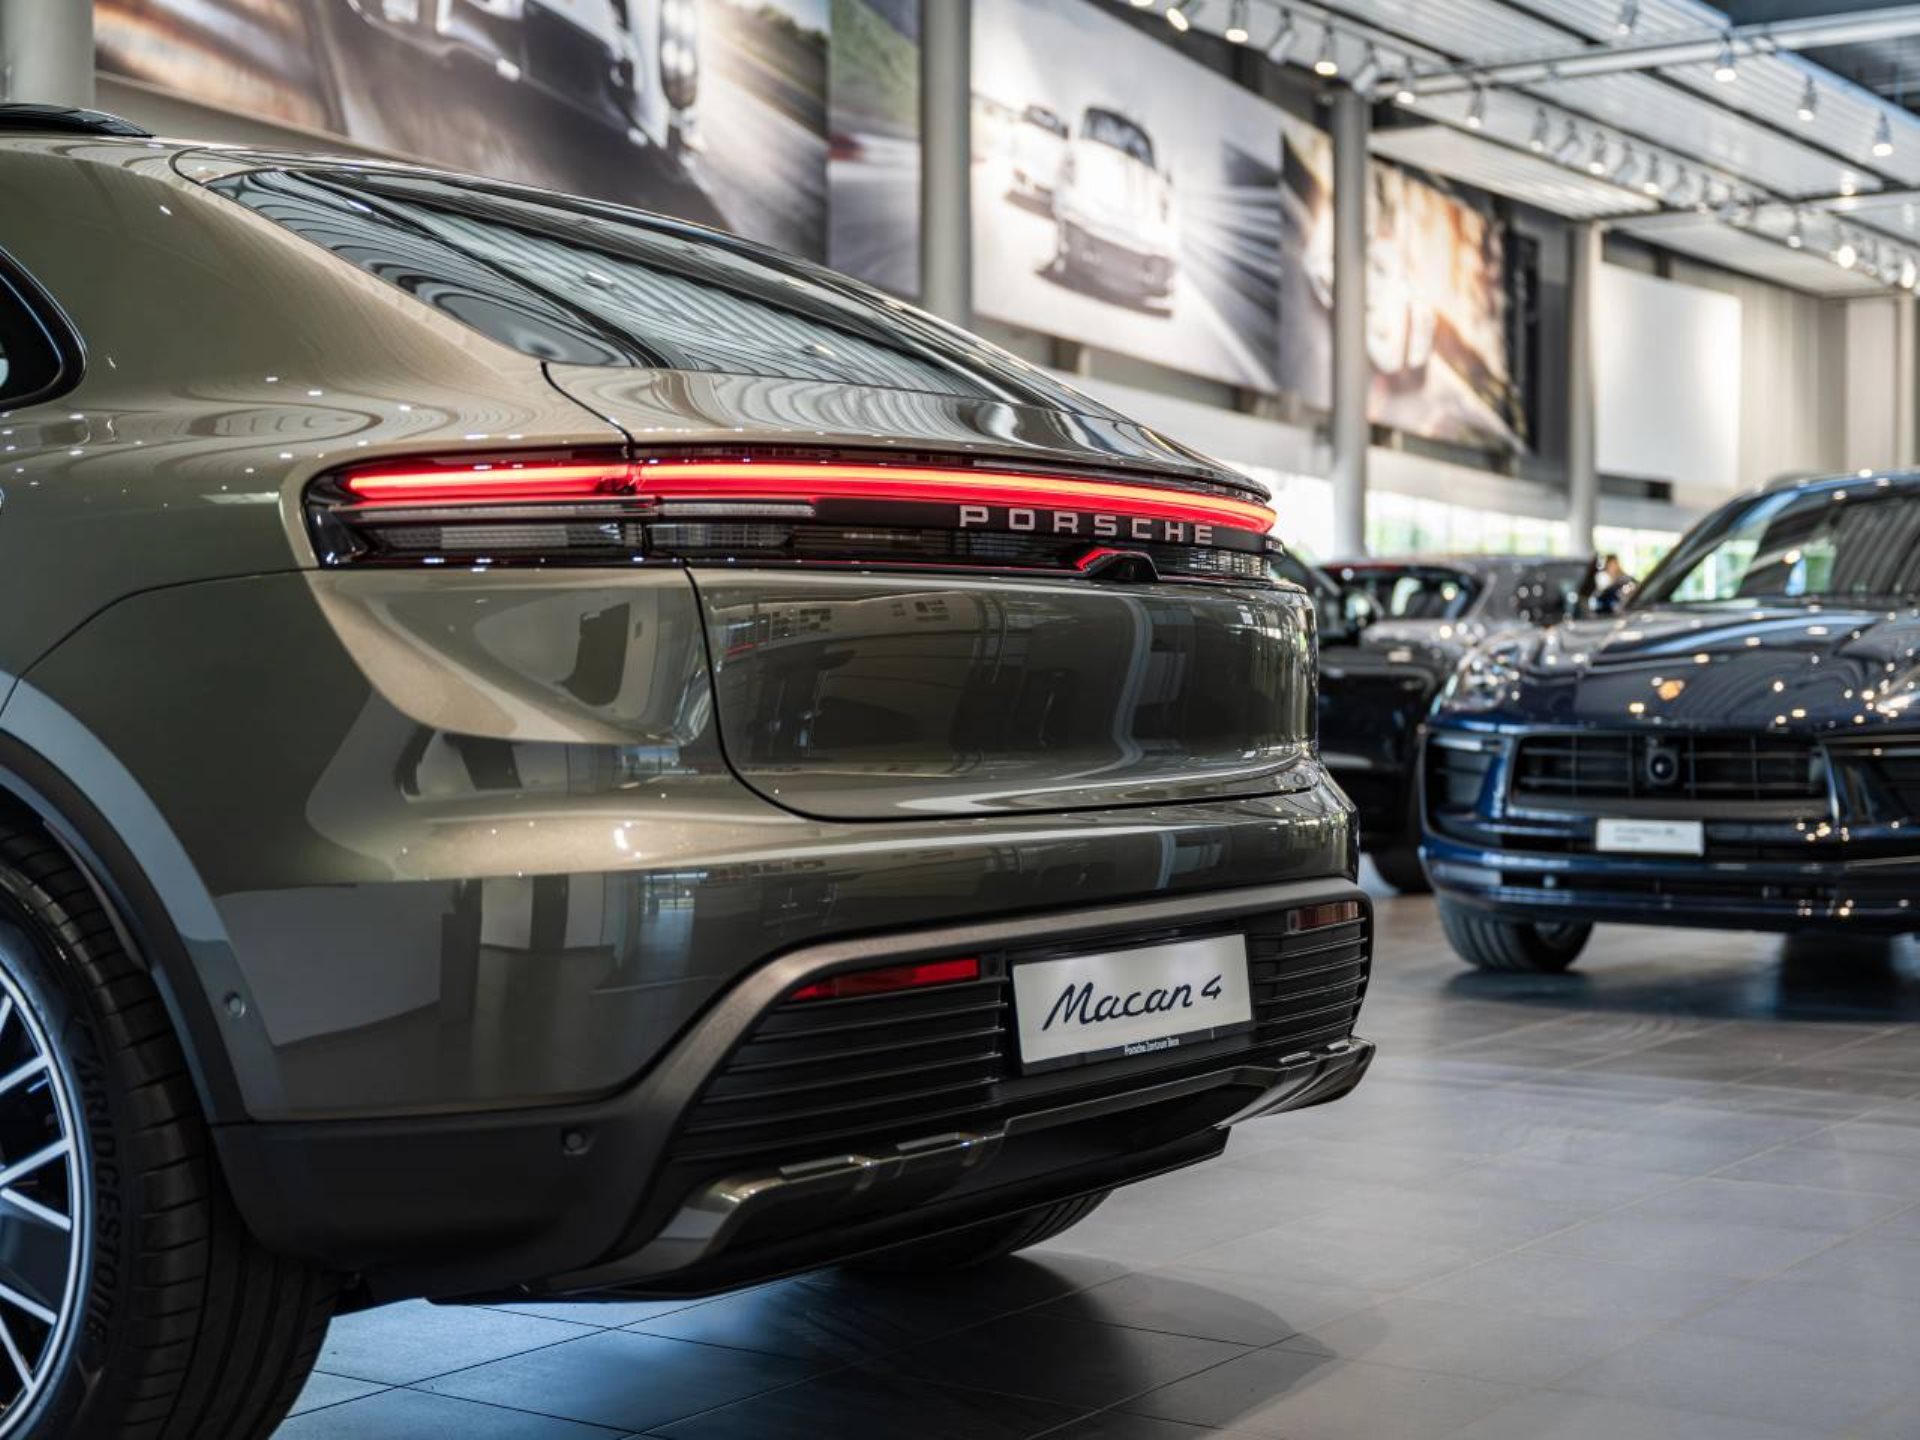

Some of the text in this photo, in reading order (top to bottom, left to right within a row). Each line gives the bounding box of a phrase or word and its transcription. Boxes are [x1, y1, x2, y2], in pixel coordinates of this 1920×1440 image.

[959, 505, 1213, 544] PORSCHE
[1042, 974, 1222, 1031] Macan 4
[71, 1055, 121, 1345] BRIDGESTONE
